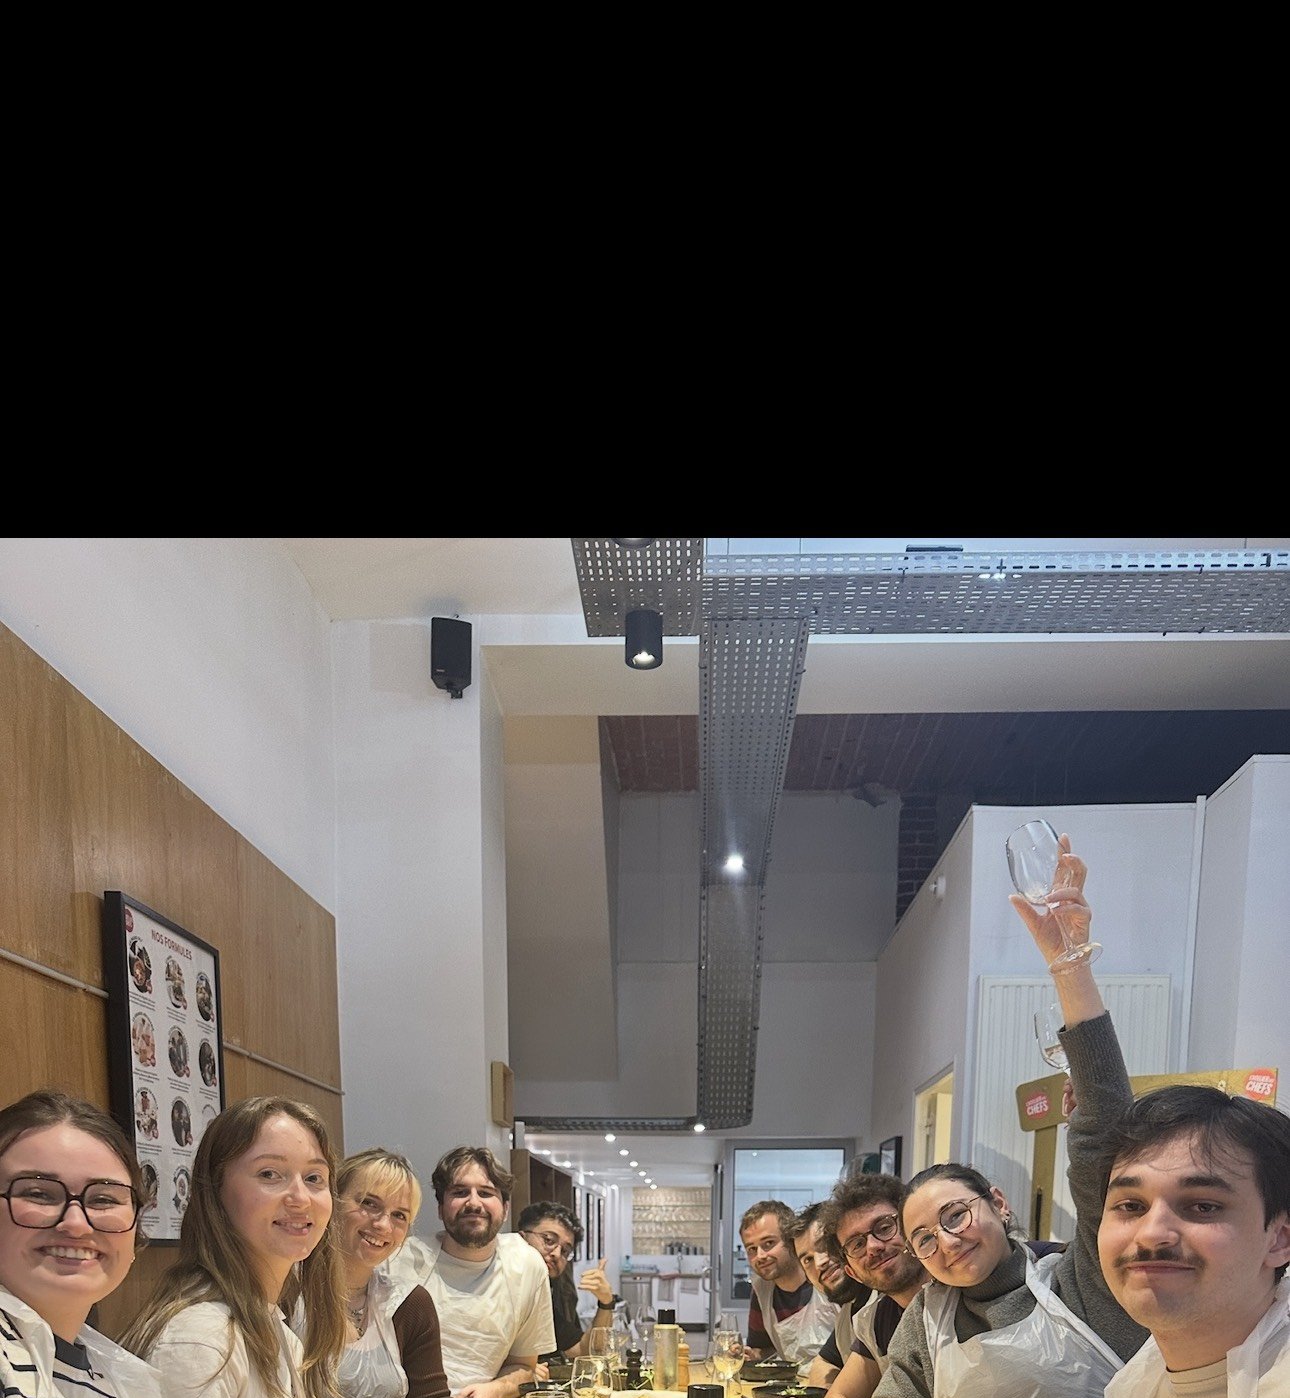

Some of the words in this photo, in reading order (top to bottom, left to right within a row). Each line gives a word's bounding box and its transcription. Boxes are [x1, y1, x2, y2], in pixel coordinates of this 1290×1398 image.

[151, 929, 164, 947] NOS
[164, 936, 193, 961] FORMULES
[1246, 1080, 1273, 1095] CHEFS
[1026, 1100, 1049, 1116] CHEFS
